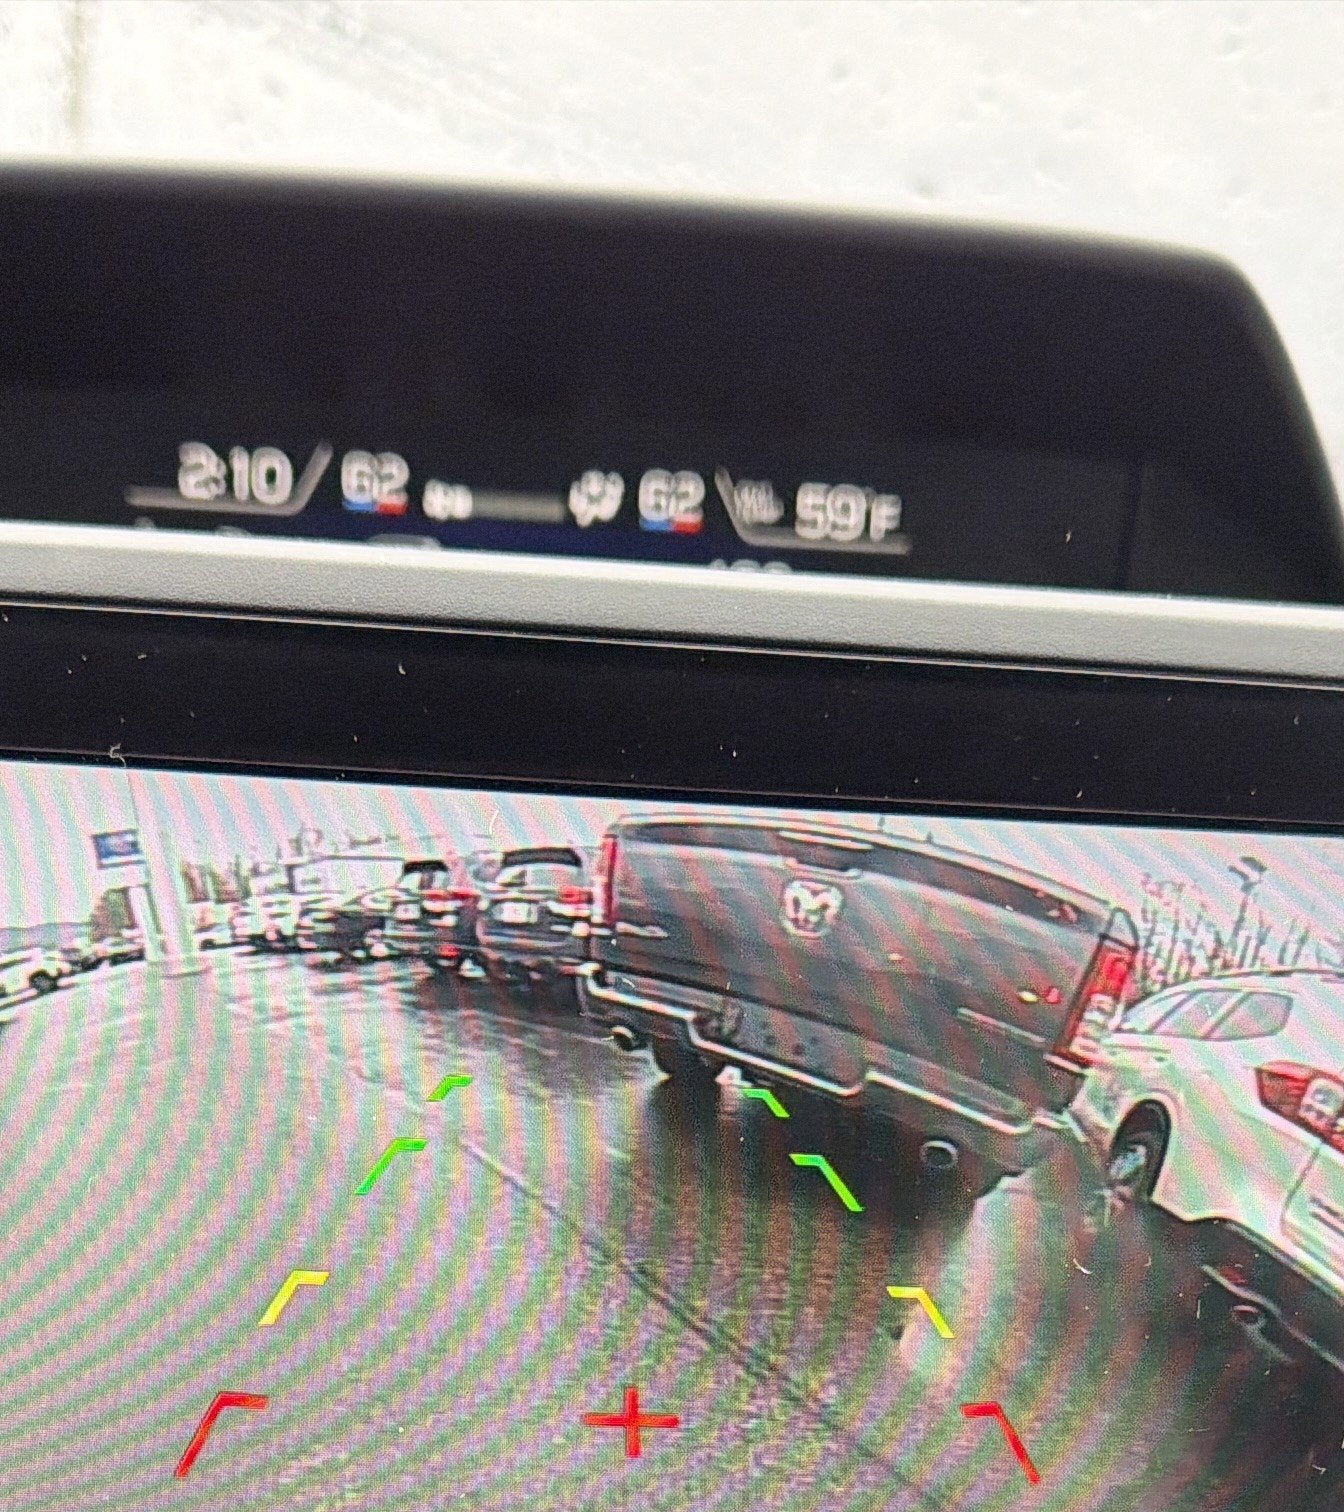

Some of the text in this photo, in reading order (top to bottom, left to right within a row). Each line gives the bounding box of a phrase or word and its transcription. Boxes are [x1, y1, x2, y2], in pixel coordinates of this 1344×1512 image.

[177, 441, 293, 504] 2:10
[341, 450, 410, 504] 62
[638, 468, 705, 522] 62
